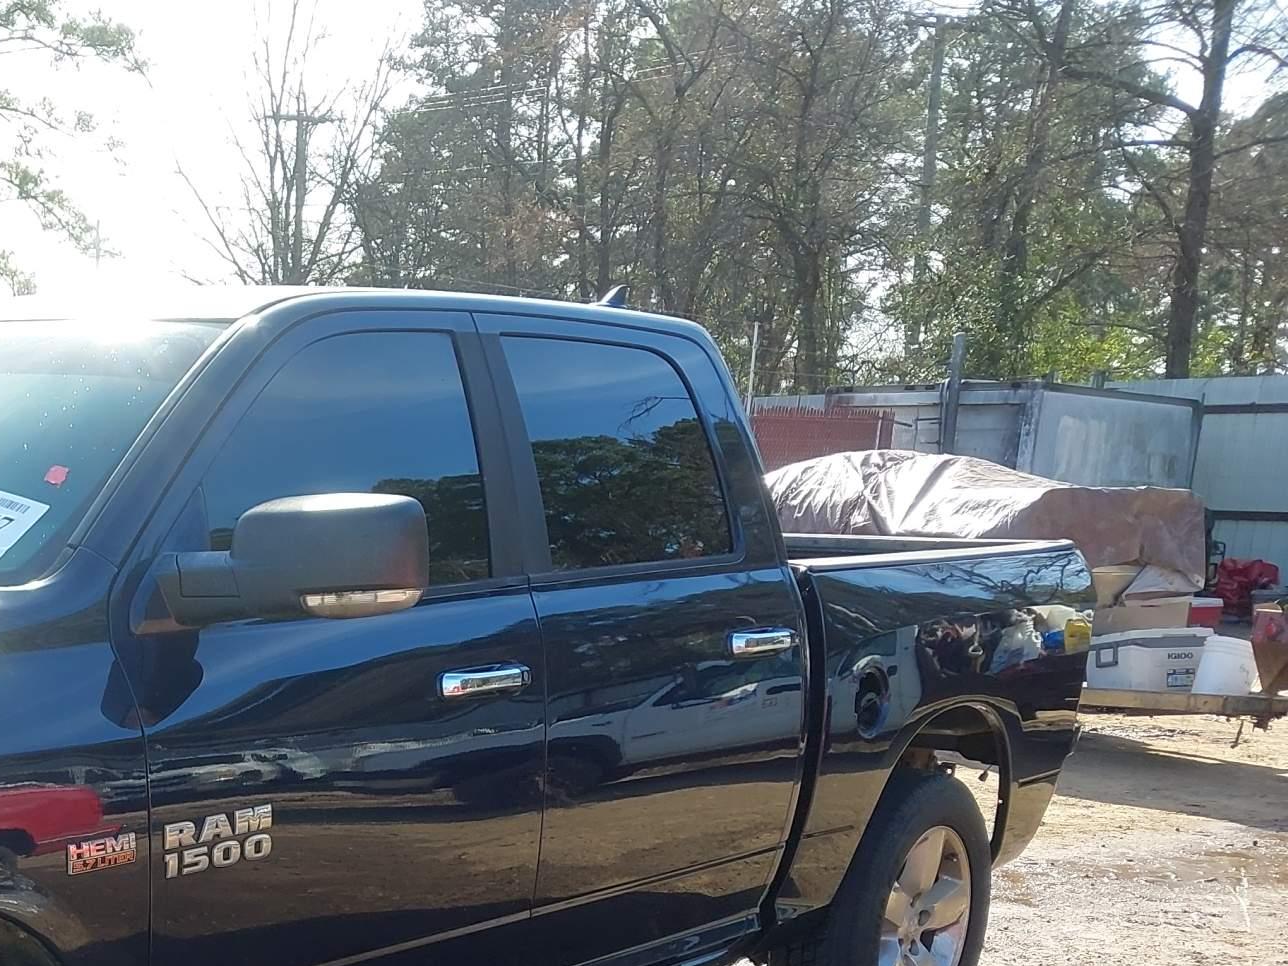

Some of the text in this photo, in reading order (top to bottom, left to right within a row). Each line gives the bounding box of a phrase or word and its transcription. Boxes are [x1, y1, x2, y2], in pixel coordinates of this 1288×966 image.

[164, 803, 273, 850] RAM
[68, 832, 137, 861] HEMI
[73, 850, 134, 873] 5.7 LITER
[164, 834, 273, 879] 1500
